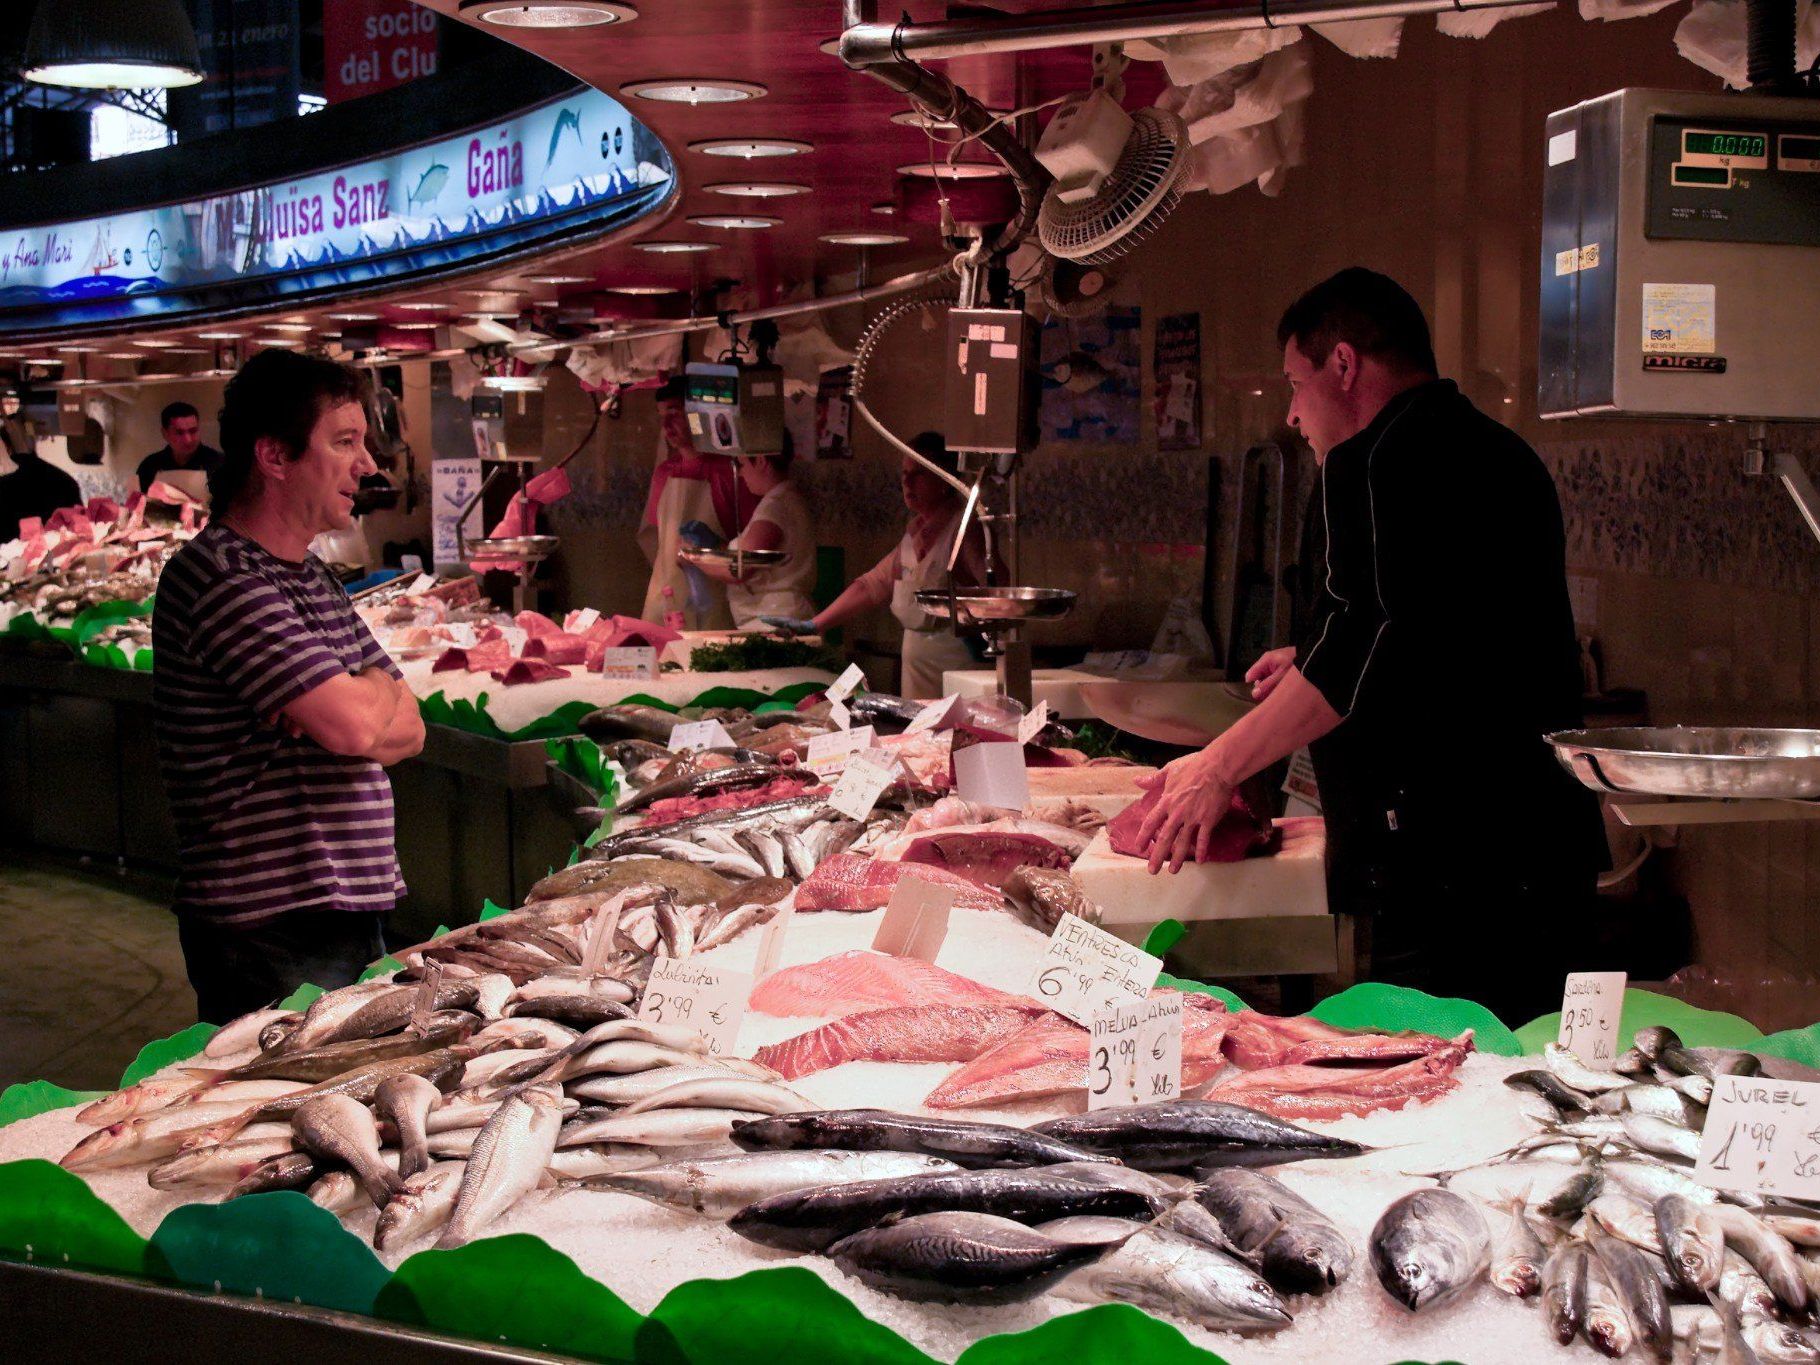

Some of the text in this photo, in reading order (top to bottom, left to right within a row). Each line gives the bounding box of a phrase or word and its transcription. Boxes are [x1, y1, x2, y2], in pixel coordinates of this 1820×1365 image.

[365, 3, 437, 41] socio
[340, 51, 381, 86] del
[1712, 136, 1764, 156] 0.000
[467, 129, 524, 199] Gaña
[1720, 157, 1730, 167] kg
[333, 176, 391, 230] Sanz
[14, 236, 40, 269] Ana
[708, 1002, 728, 1026] €
[1151, 1032, 1168, 1061] €
[1721, 1079, 1808, 1107] JUREL
